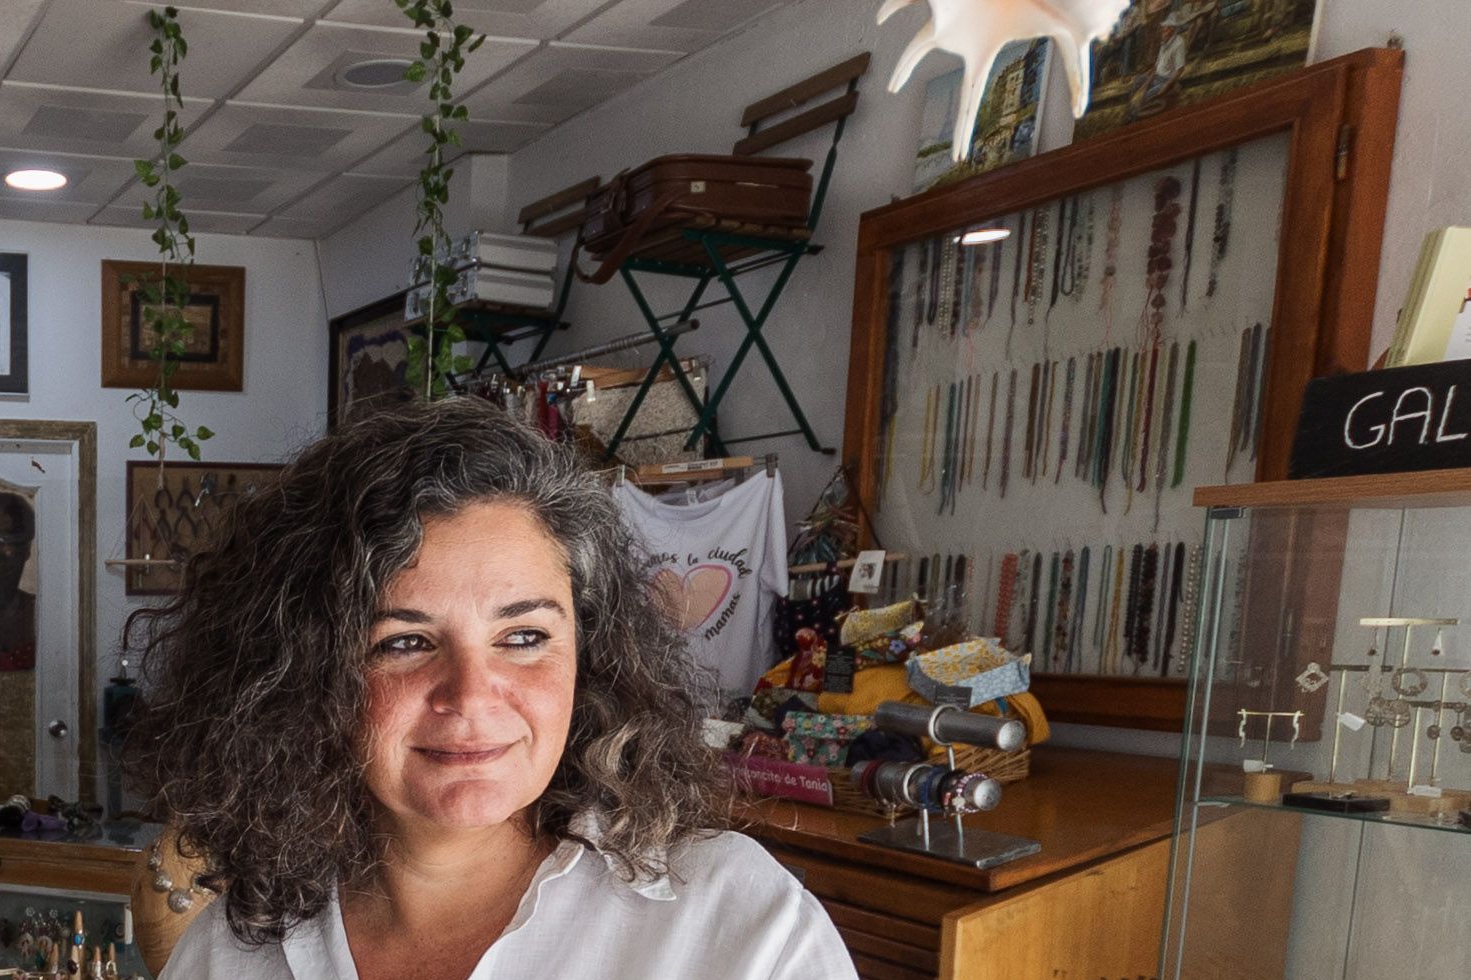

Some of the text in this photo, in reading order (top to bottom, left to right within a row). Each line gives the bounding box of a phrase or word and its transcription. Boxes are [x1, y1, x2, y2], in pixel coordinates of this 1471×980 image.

[1344, 384, 1468, 450] GAL
[707, 546, 753, 579] ciudad
[784, 774, 798, 786] de
[799, 775, 829, 792] Tania
